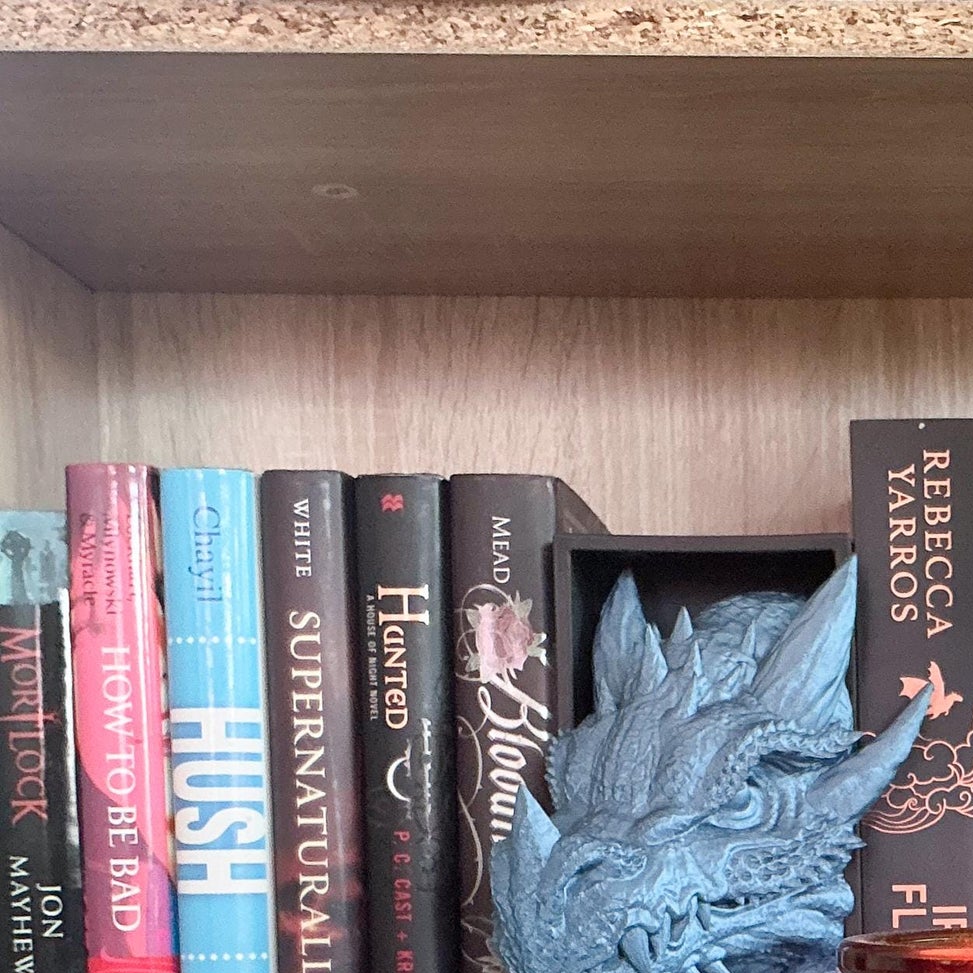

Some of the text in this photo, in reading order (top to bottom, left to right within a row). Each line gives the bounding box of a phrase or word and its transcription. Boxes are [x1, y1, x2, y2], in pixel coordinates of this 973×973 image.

[79, 533, 98, 606] Myracle
[188, 506, 222, 602] Chayil
[294, 498, 312, 577] WHITE
[492, 516, 511, 584] MEAD
[888, 464, 918, 622] YARROS
[922, 449, 953, 639] REBECCA
[366, 605, 376, 636] HOUSE
[367, 641, 376, 653] OF
[368, 658, 378, 687] NIGHT
[369, 690, 379, 721] NOVEL
[0, 625, 58, 826] MORTLOCK
[102, 646, 141, 932] HOW TO BE BAD
[170, 708, 267, 894] HUSH
[36, 883, 64, 939] JON
[394, 879, 412, 922] CAST
